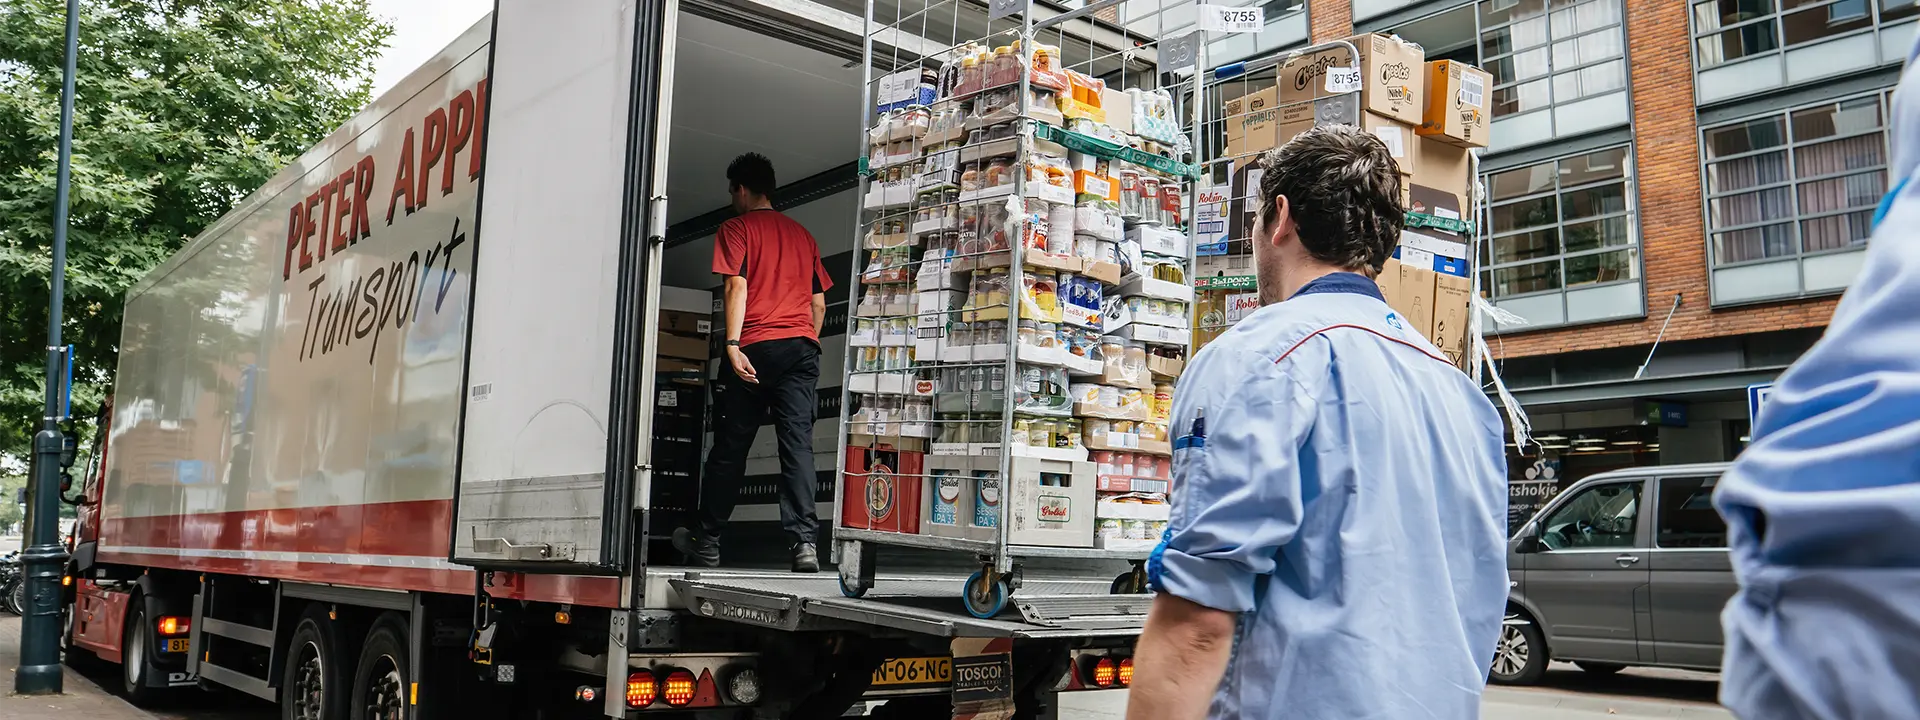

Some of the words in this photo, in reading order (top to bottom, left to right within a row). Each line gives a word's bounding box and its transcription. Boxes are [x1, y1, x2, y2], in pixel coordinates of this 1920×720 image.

[1224, 11, 1256, 22] 8755
[1294, 55, 1338, 92] Cheetos
[1334, 71, 1360, 84] 8755
[1380, 62, 1410, 85] Cheetos
[283, 155, 376, 283] PETER
[299, 217, 466, 367] Transport
[1195, 279, 1209, 288] RIEL
[1041, 505, 1067, 517] Grolsch
